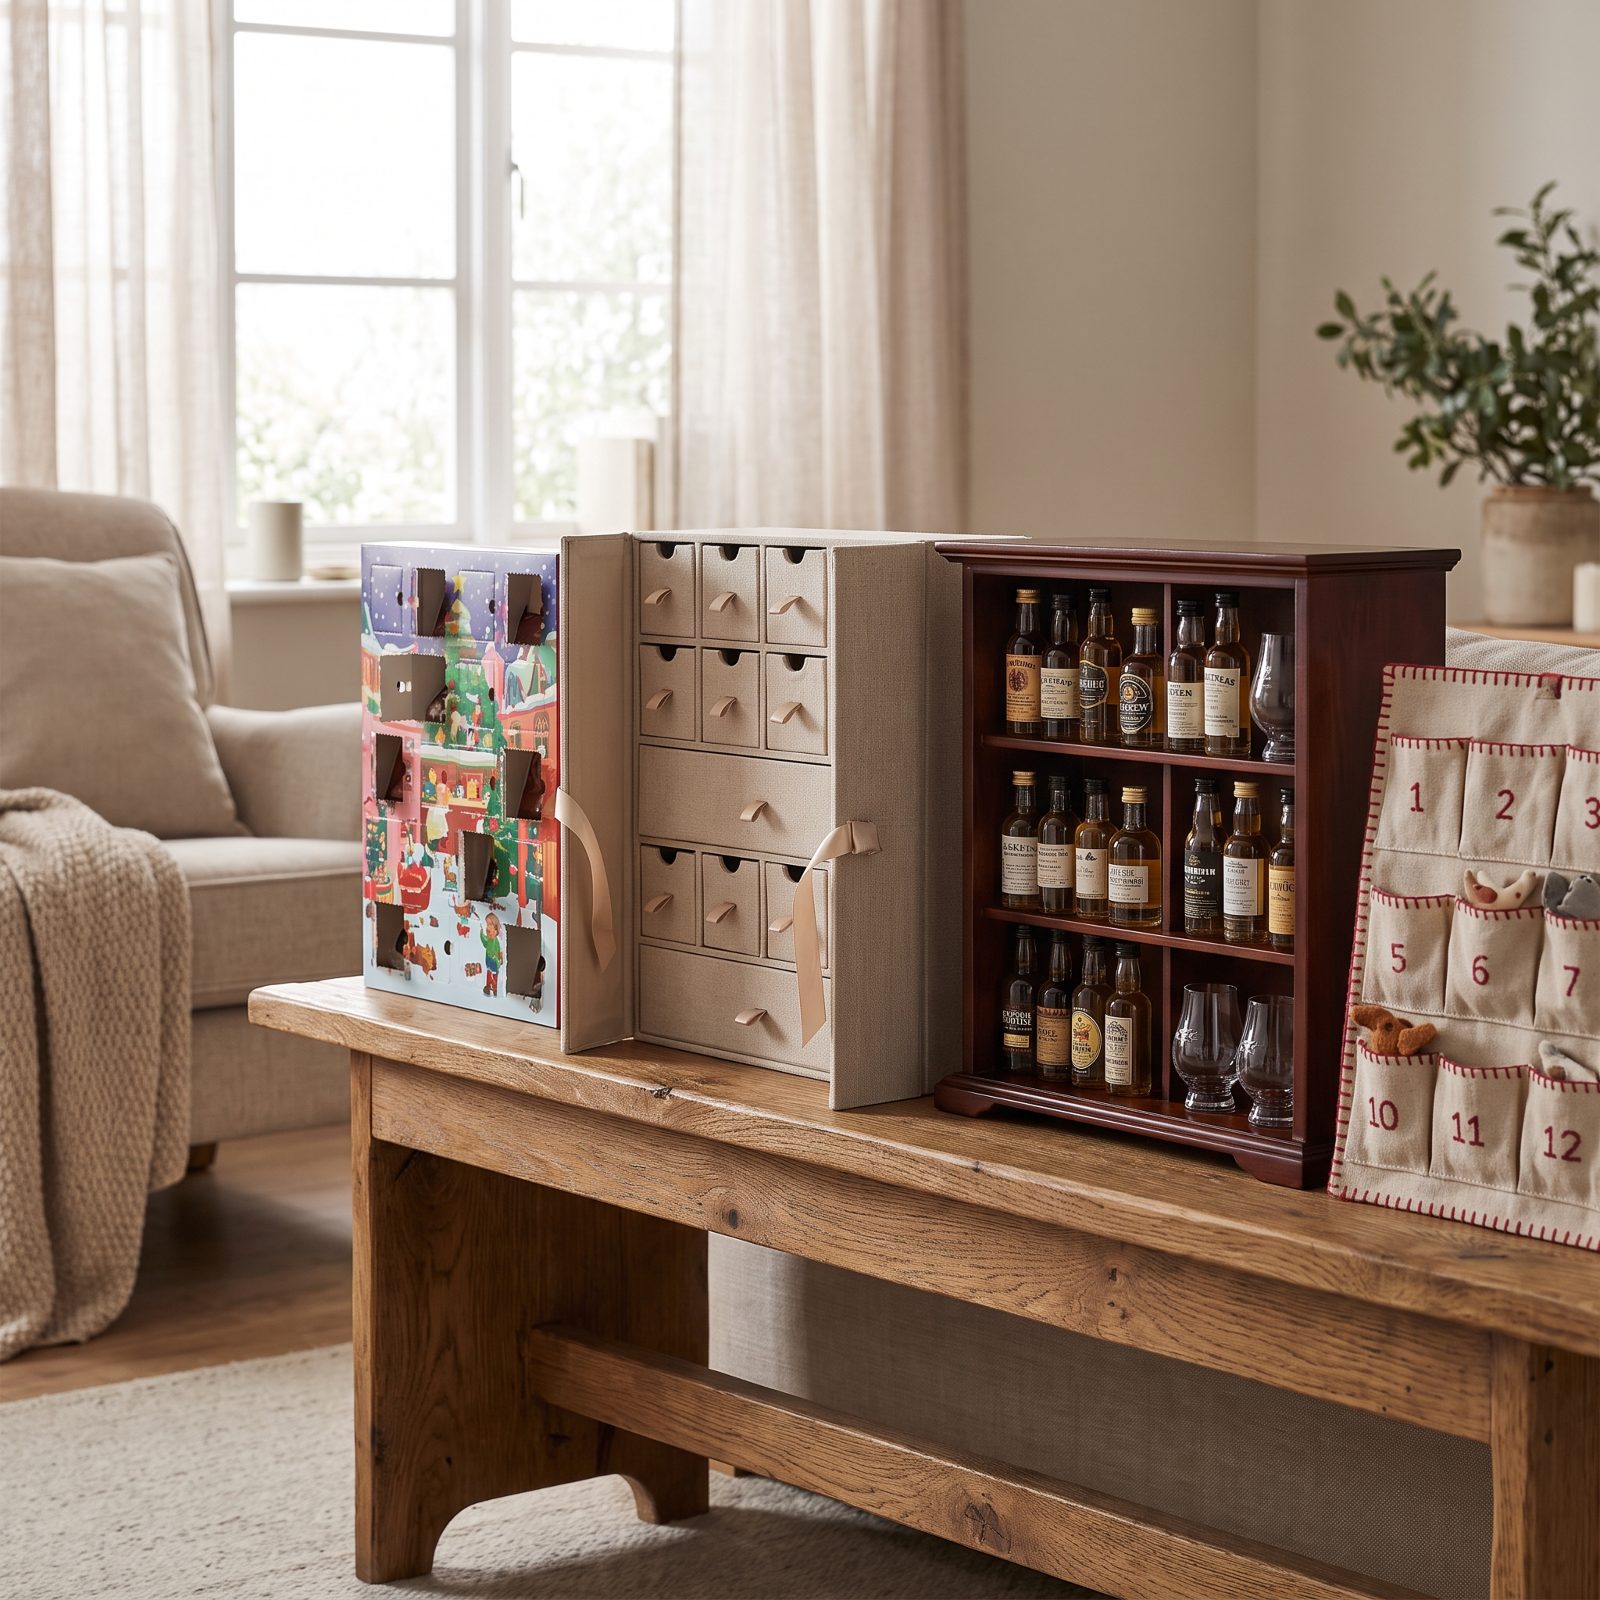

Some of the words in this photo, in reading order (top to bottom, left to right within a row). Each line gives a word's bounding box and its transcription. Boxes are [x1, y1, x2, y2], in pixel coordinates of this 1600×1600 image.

[1411, 783, 1424, 813] 1
[1496, 790, 1515, 821] 2
[1585, 797, 1600, 829] 3
[1391, 943, 1407, 974] 5
[1472, 955, 1490, 986] 6
[1564, 966, 1581, 997] 7
[1368, 1097, 1399, 1131] 10
[1452, 1112, 1484, 1147] 11
[1544, 1126, 1581, 1162] 12
